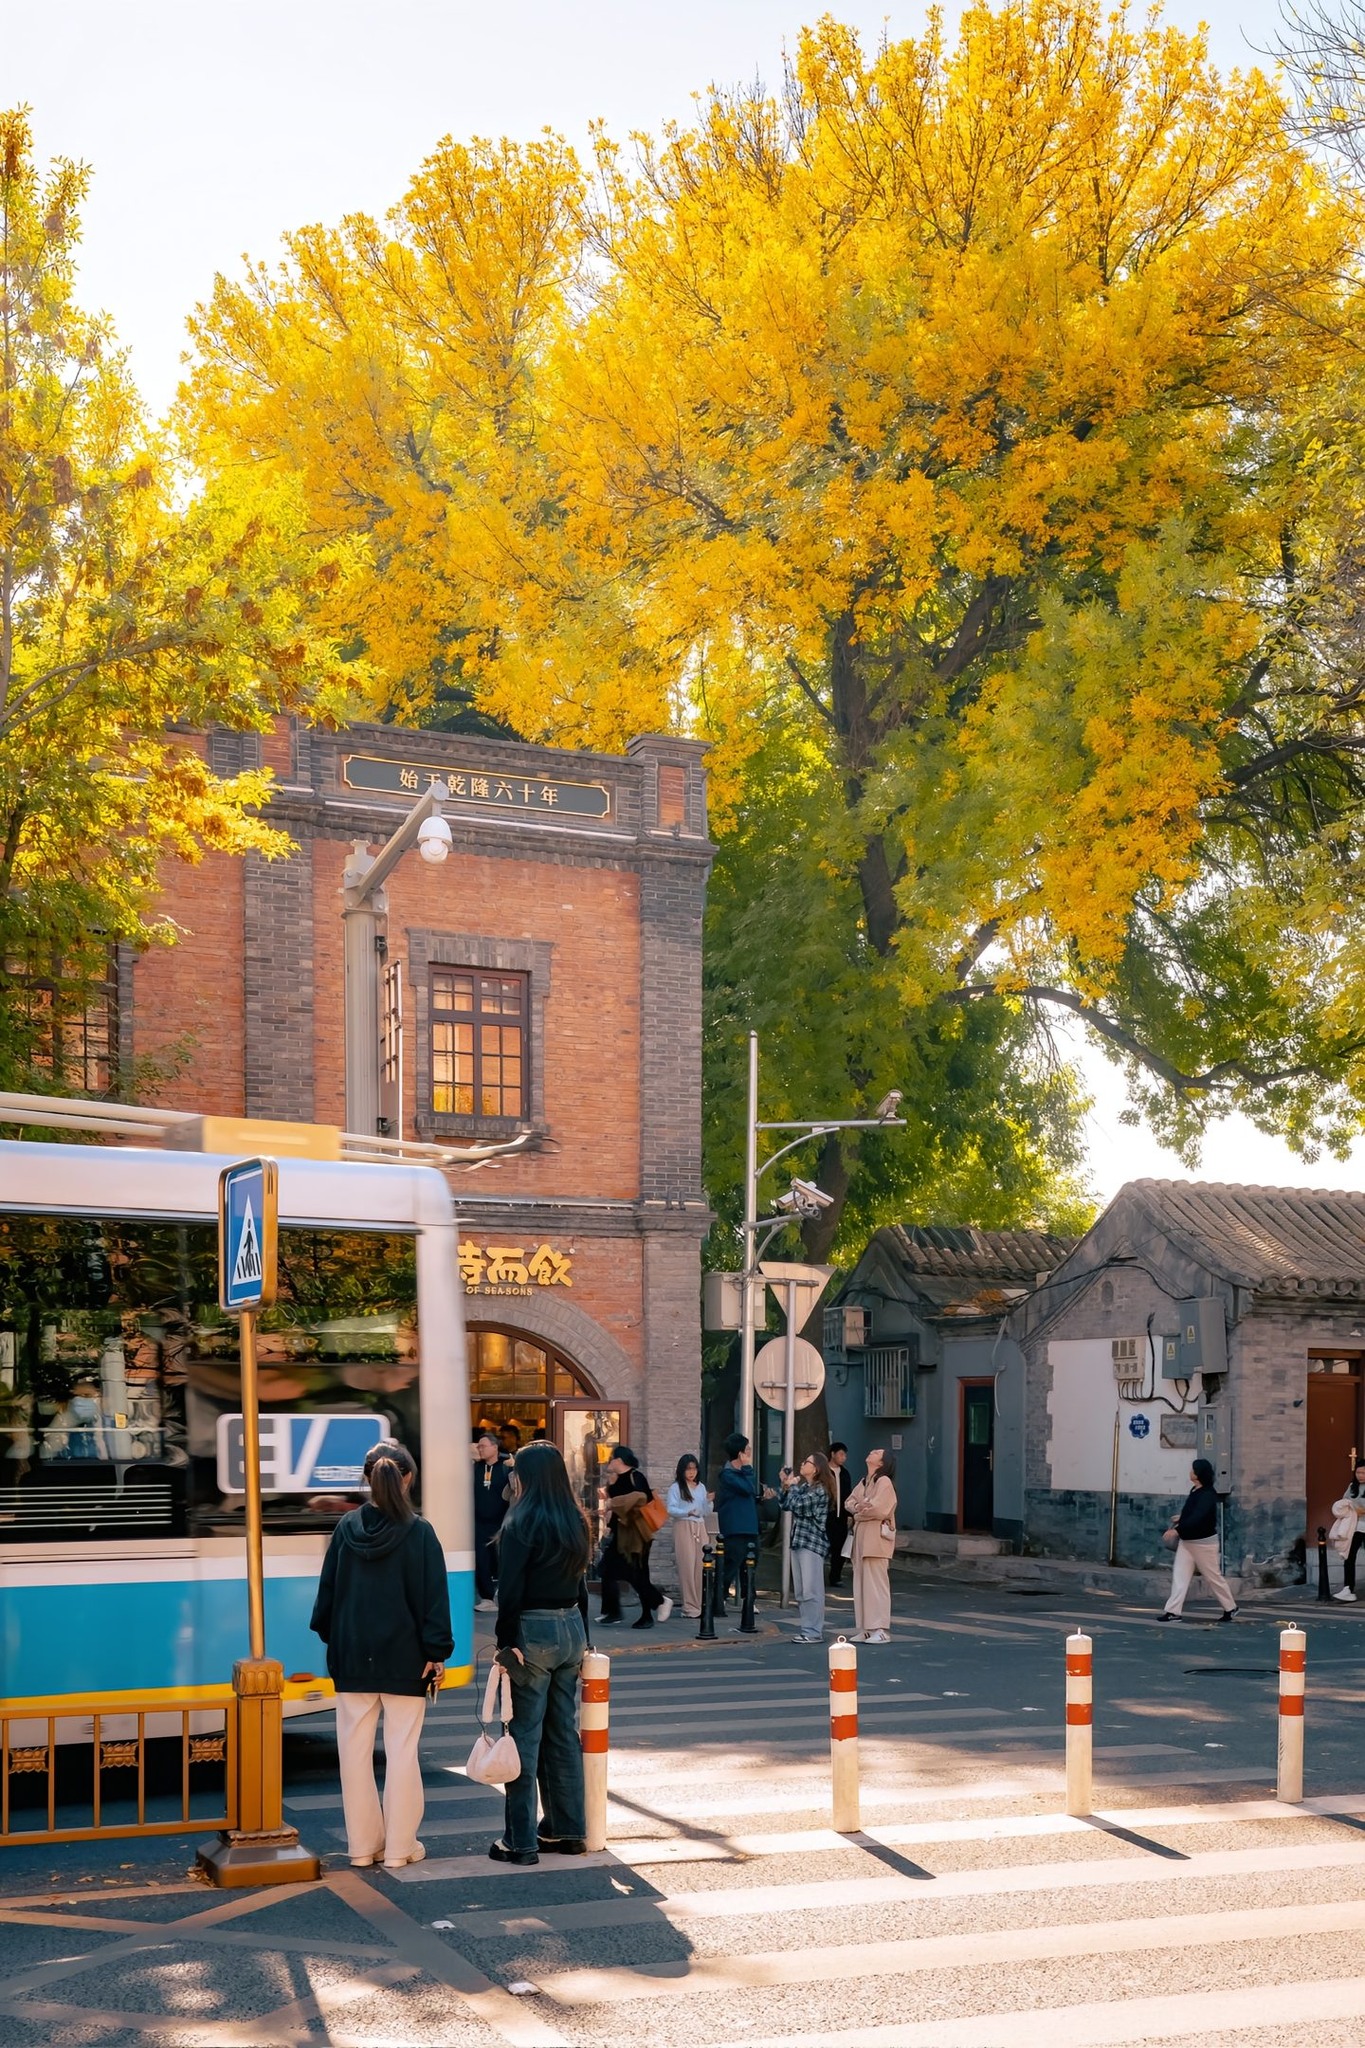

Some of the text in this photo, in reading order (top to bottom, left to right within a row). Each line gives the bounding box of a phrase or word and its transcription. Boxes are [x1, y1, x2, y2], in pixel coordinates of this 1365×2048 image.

[466, 1286, 533, 1296] OF SEASONS
[228, 1416, 331, 1490] EV
